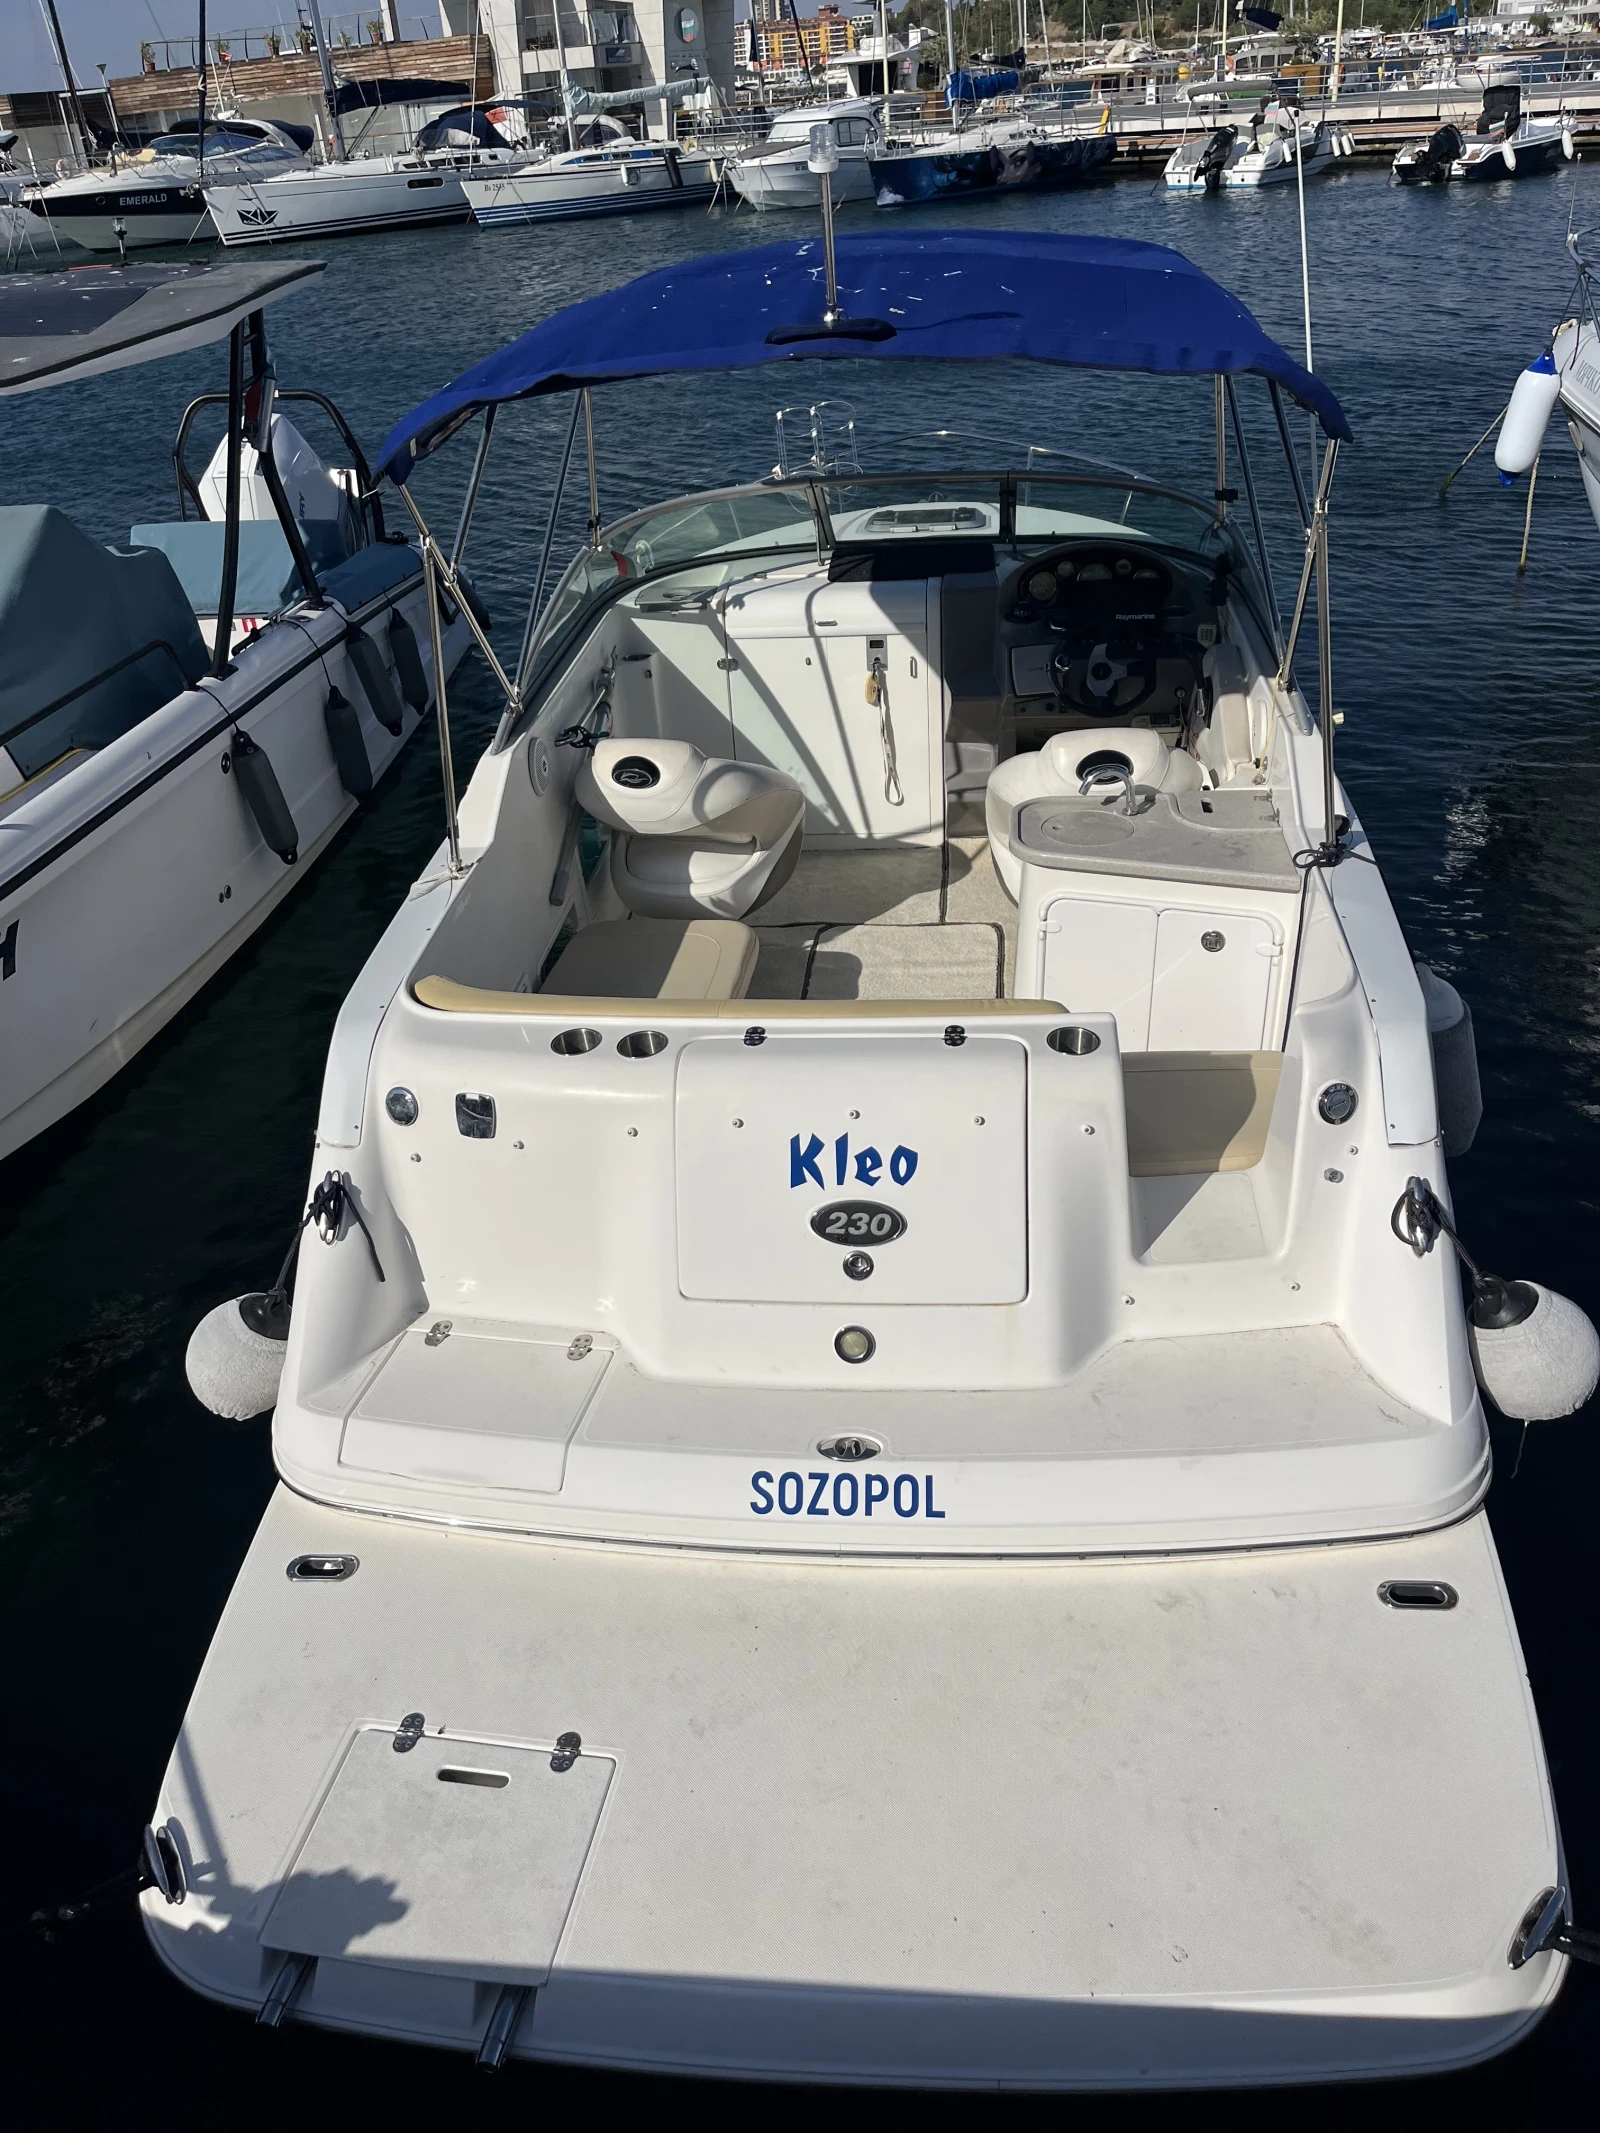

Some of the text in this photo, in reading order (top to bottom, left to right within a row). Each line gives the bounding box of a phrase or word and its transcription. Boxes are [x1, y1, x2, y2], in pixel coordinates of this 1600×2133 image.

[119, 193, 168, 206] EMERALD
[1115, 613, 1156, 621] Raymarine
[790, 1131, 919, 1192] Kleo
[825, 1211, 892, 1236] 230
[749, 1470, 946, 1519] SOZOPOL
